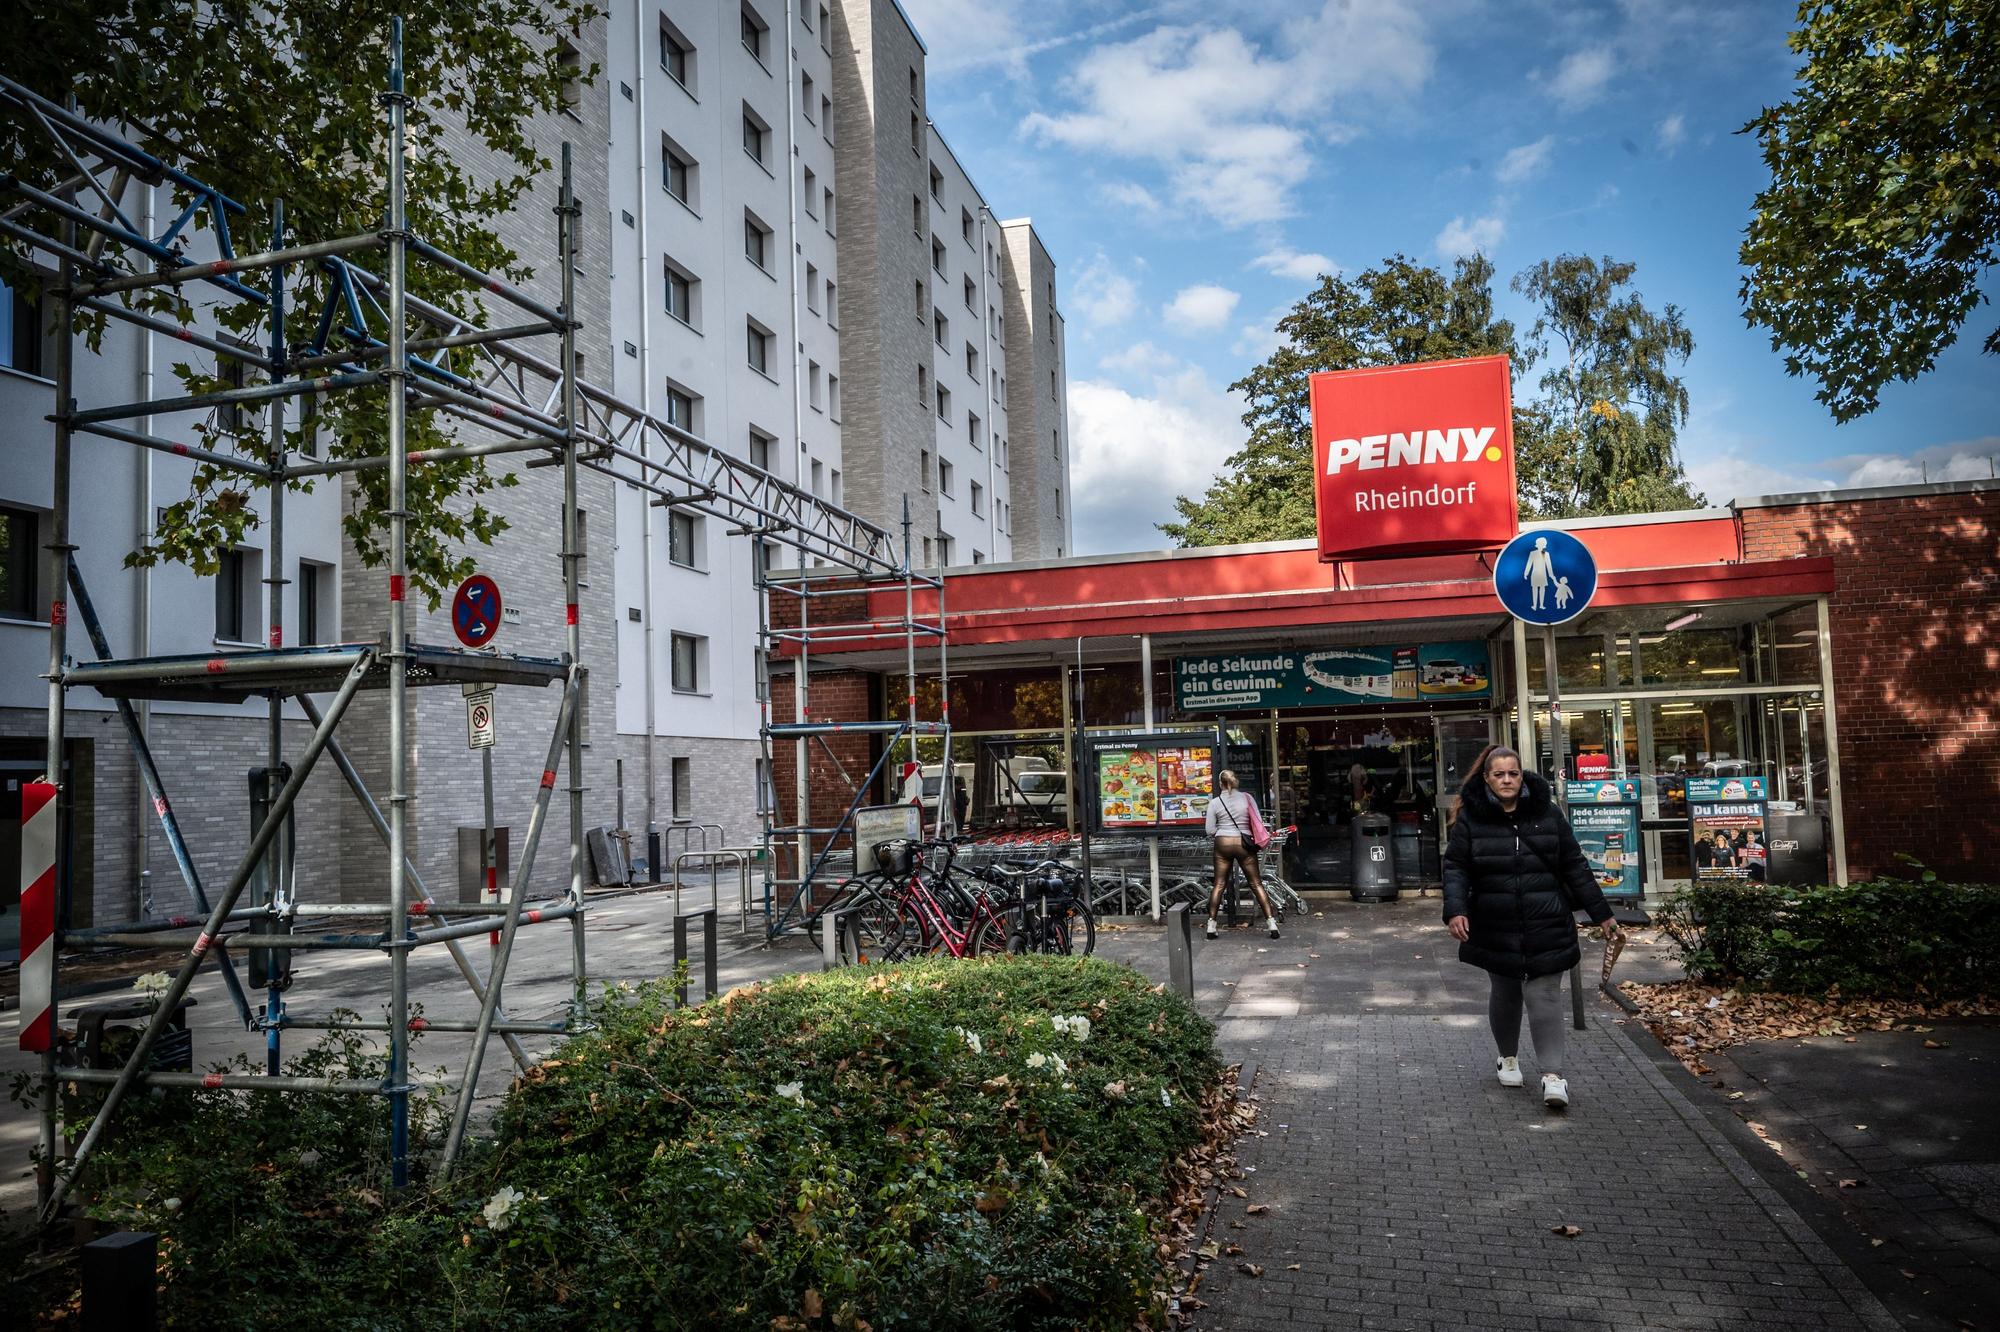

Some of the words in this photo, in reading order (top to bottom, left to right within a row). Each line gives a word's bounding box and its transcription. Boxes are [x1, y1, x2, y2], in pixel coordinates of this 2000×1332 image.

[1327, 427, 1502, 475] PENNY.
[1355, 482, 1476, 512] Rheindorf
[1181, 659, 1218, 675] Jede
[1222, 655, 1294, 673] Sekunde
[1182, 677, 1208, 692] ein
[1211, 674, 1282, 691] Gewinn.
[1594, 808, 1631, 816] Sekunde
[1693, 806, 1711, 815] Du
[1713, 804, 1760, 815] kannst
[1573, 817, 1587, 825] ein
[1588, 816, 1625, 825] Gewinn.
